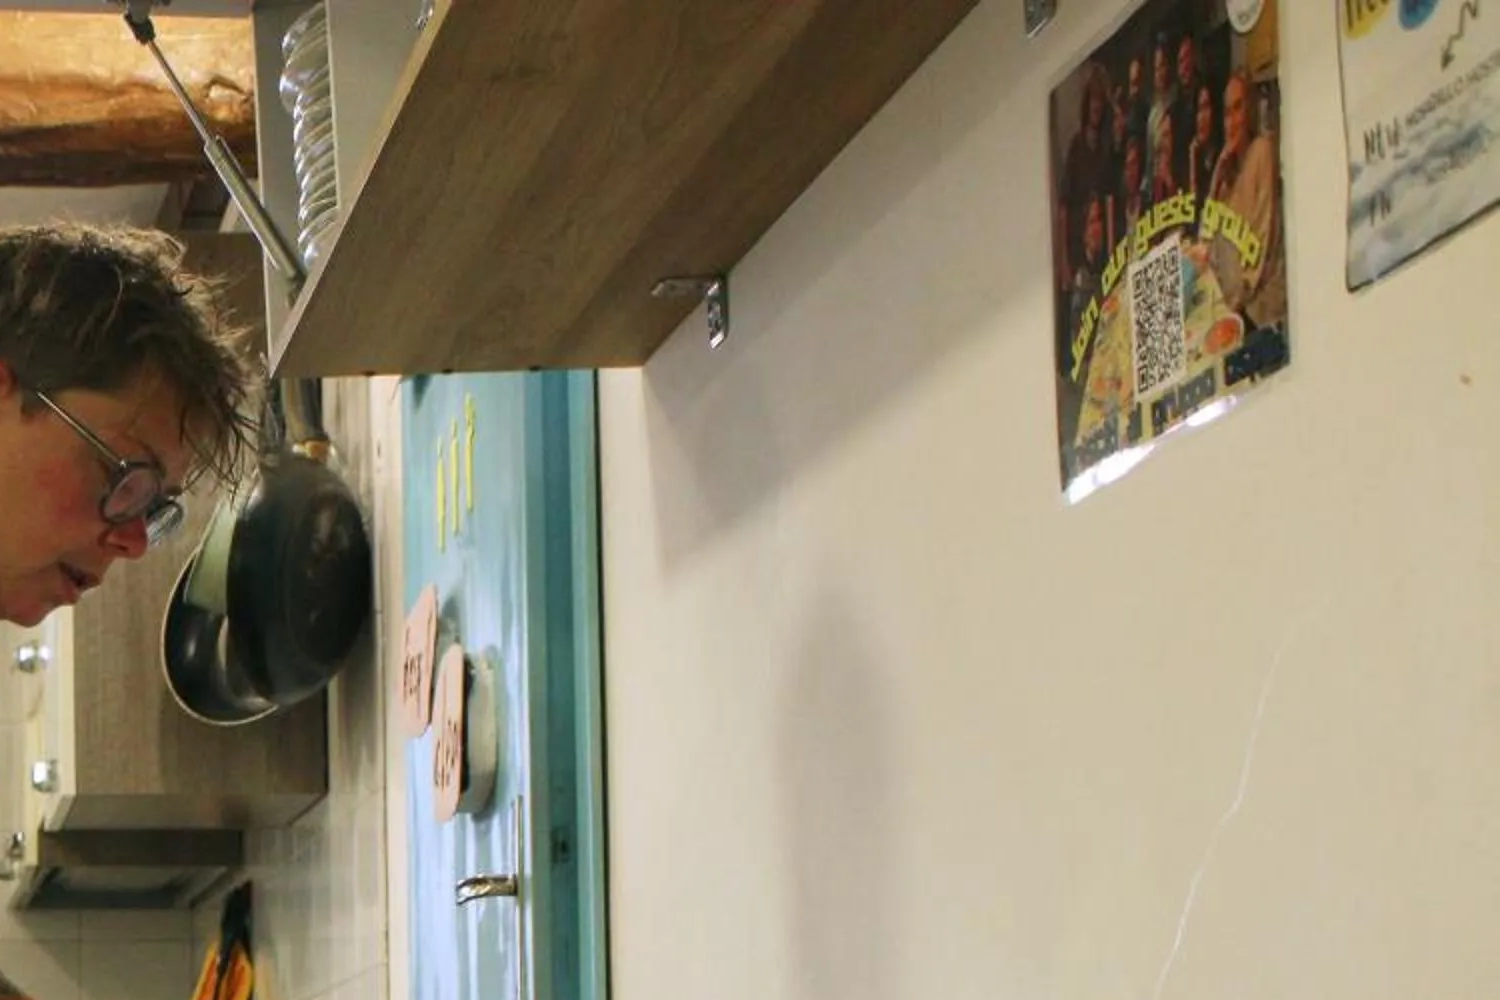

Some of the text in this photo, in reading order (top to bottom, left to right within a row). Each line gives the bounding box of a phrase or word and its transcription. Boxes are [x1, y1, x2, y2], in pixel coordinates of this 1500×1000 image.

[1101, 236, 1129, 296] our
[1133, 187, 1197, 260] guests
[1198, 197, 1262, 269] group
